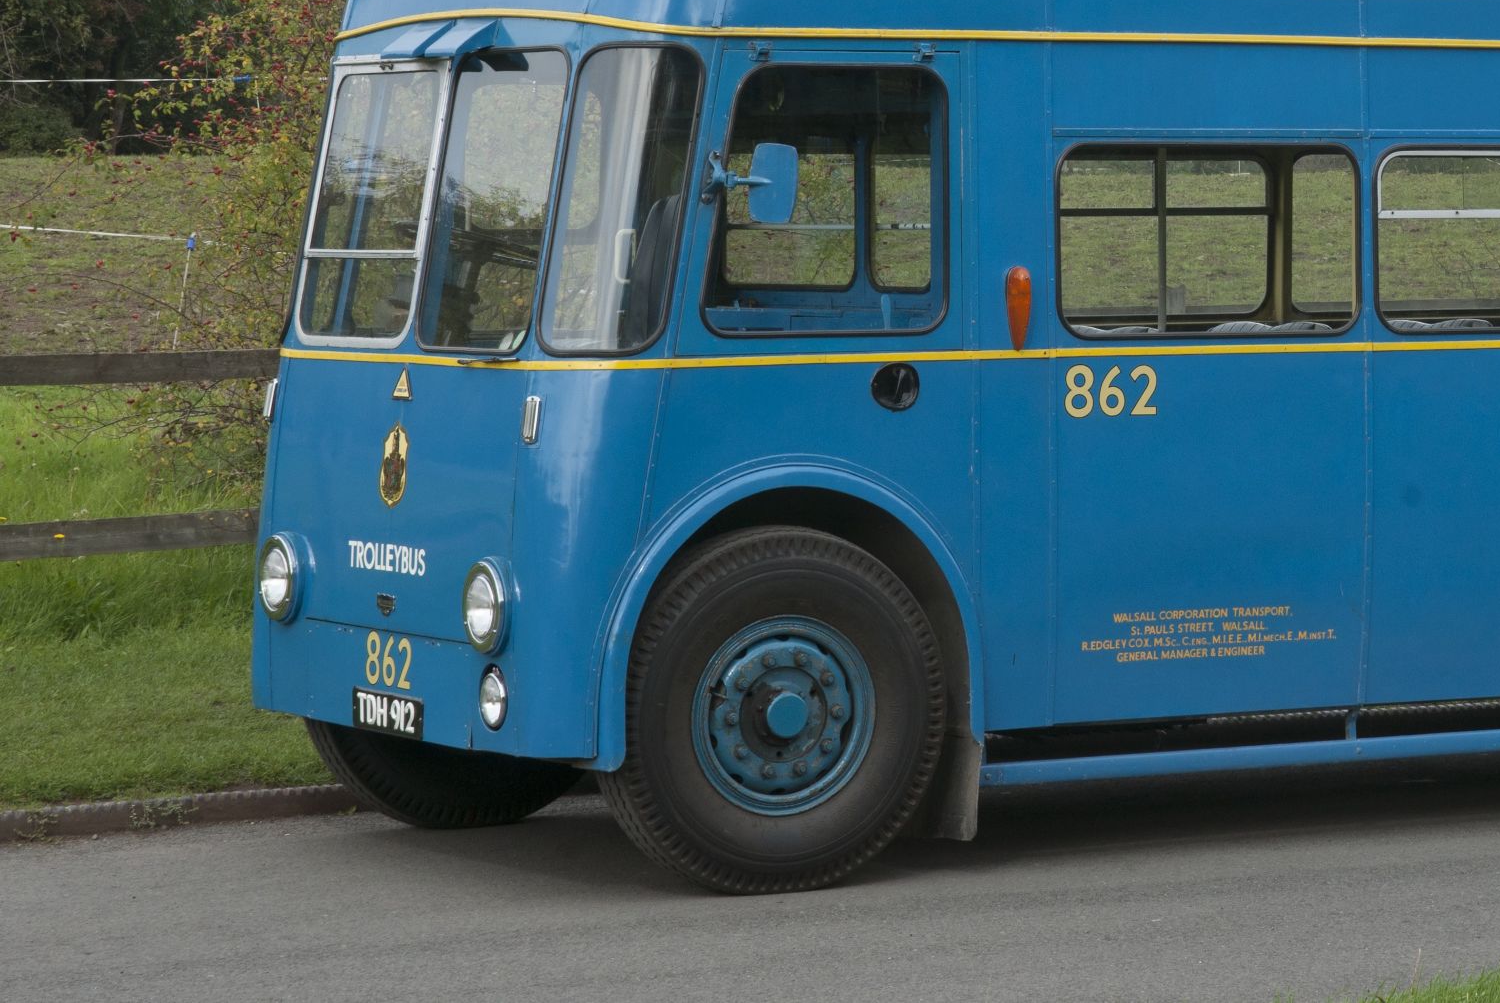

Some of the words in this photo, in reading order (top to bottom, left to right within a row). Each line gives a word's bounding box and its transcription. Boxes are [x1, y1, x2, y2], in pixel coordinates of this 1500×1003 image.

[1063, 363, 1158, 418] 862
[348, 540, 426, 577] TROLLEYBUS
[1113, 611, 1156, 623] WALSALL
[1159, 607, 1228, 620] CORPORATION
[1144, 624, 1174, 635] PAULS
[365, 630, 413, 690] 862
[1116, 651, 1158, 662] GENERAL
[1160, 648, 1208, 660] MANAGER
[1210, 647, 1216, 657] &
[1217, 645, 1265, 657] ENGINEER
[356, 692, 388, 727] TDH
[390, 699, 415, 733] 912
